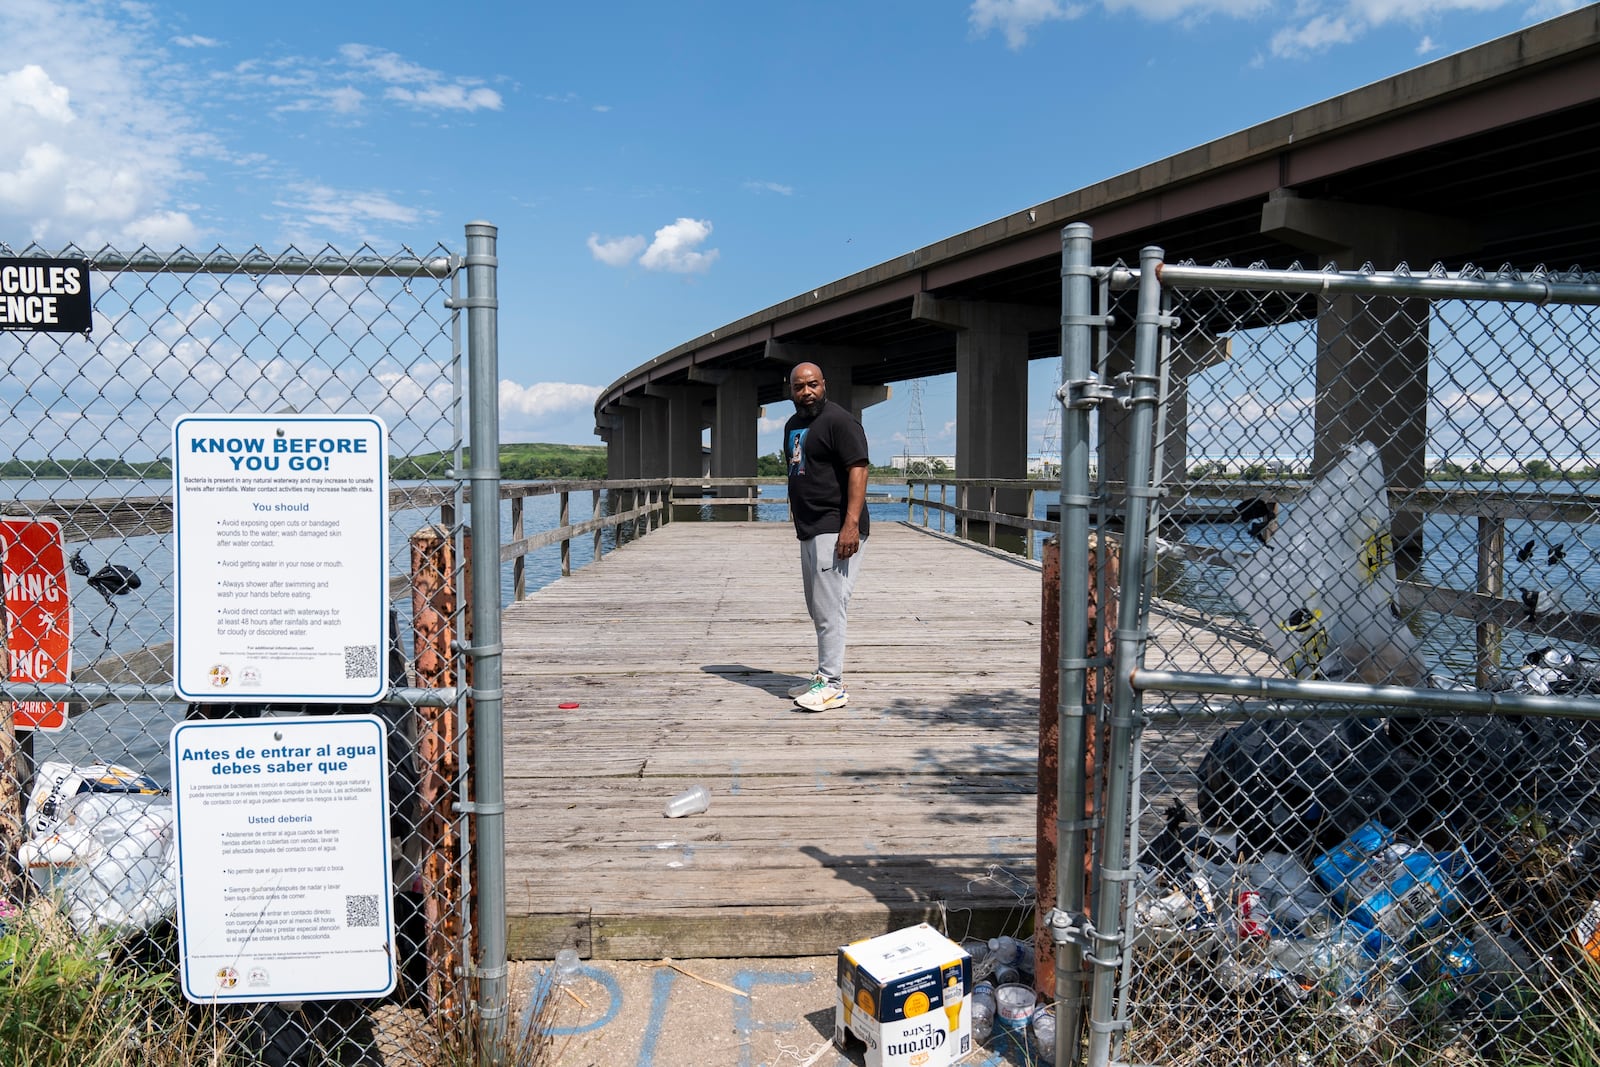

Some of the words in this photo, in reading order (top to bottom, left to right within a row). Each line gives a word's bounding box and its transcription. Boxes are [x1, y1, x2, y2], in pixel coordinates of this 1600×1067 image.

[0, 266, 81, 295] CULES
[191, 438, 264, 452] KNOW
[273, 438, 366, 452] BEFORE
[229, 456, 279, 470] YOU
[288, 456, 328, 470] GO!
[252, 502, 271, 511] You
[274, 502, 309, 511] should
[222, 580, 244, 588] Always
[285, 580, 315, 589] swimming
[297, 608, 329, 616] waterways
[226, 628, 247, 636] cloudy
[182, 747, 229, 760] Antes
[235, 746, 254, 758] de
[261, 745, 310, 758] entrar
[316, 744, 330, 756] al
[336, 745, 376, 758] agua
[211, 761, 260, 774] debes
[267, 760, 312, 772] saber
[318, 762, 348, 774] que
[903, 1024, 931, 1037] Extra
[888, 1029, 946, 1056] Corona
